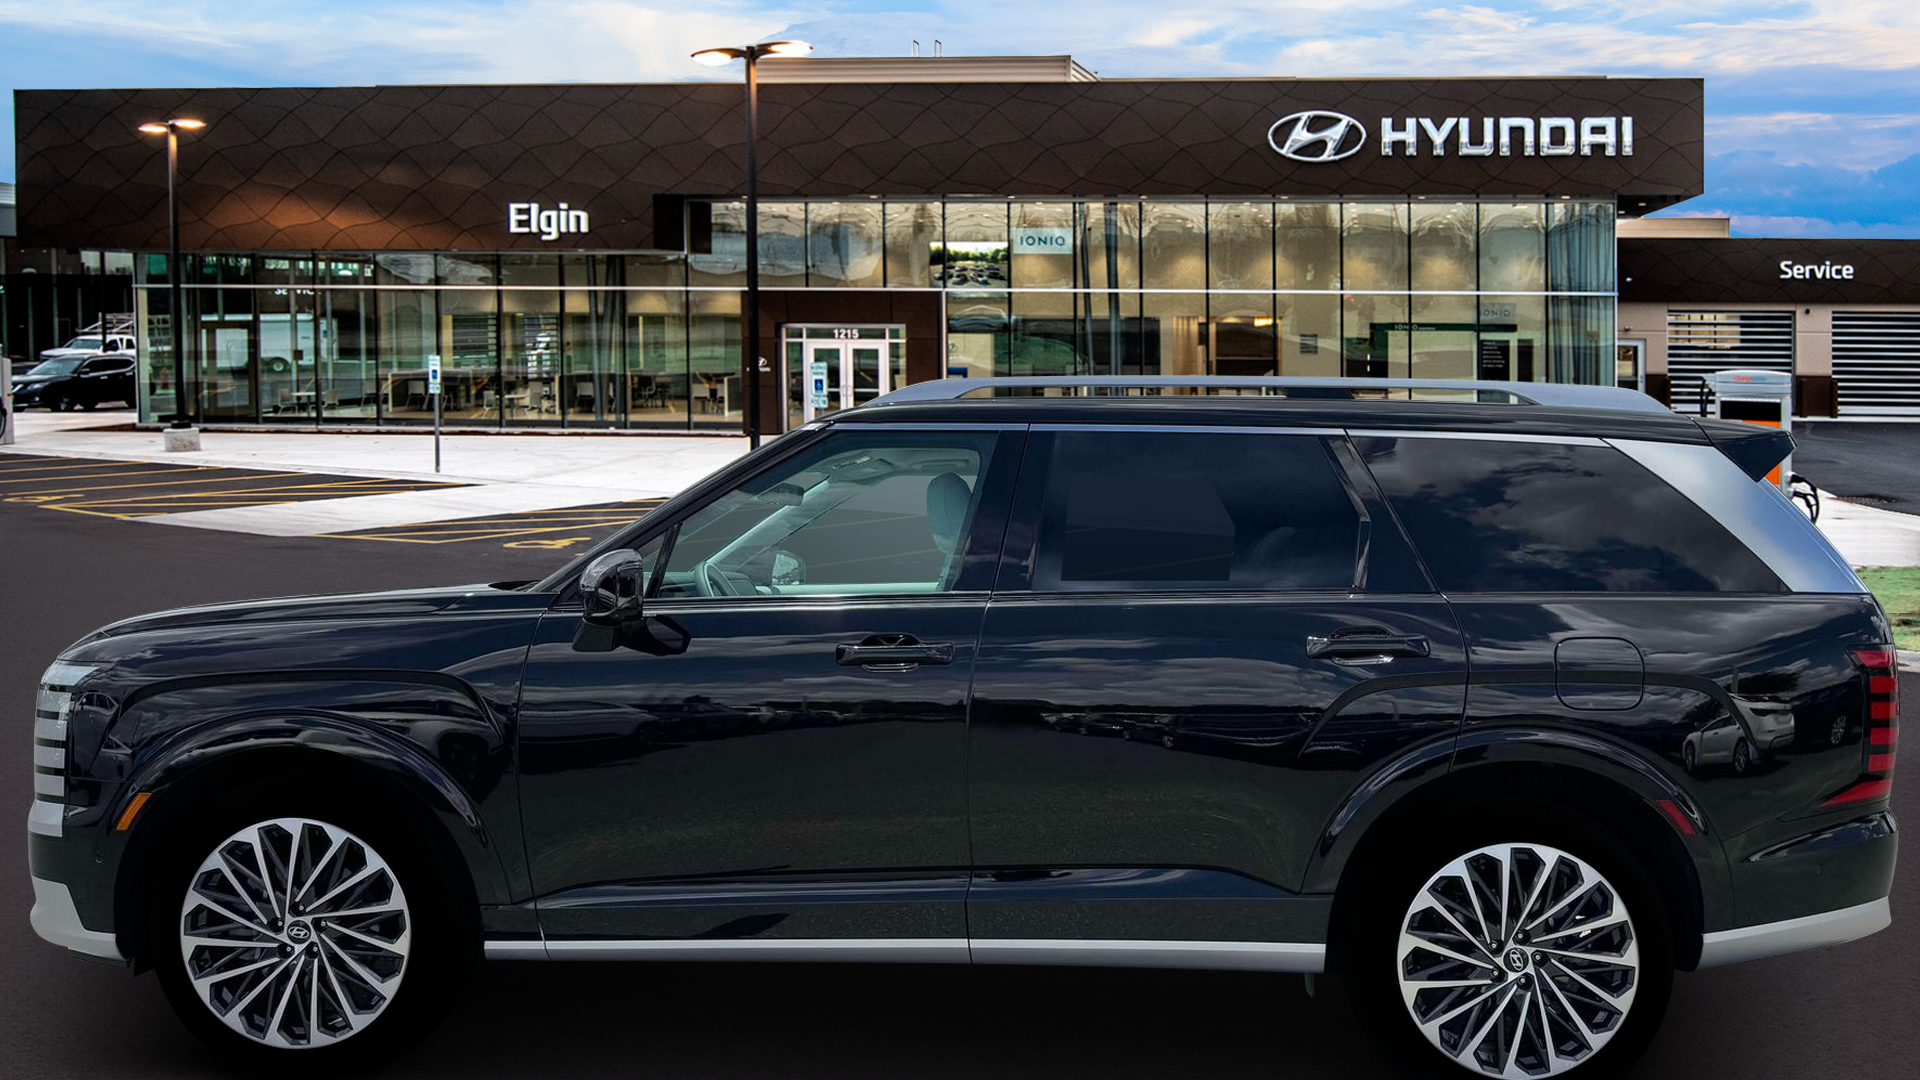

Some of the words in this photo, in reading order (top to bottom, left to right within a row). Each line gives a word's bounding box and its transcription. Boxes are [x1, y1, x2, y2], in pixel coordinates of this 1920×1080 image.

[1380, 116, 1633, 157] HYUNDAI
[508, 202, 590, 241] Elgin
[1020, 235, 1066, 247] IONIQ
[1779, 260, 1855, 280] Service
[833, 328, 860, 339] 1215
